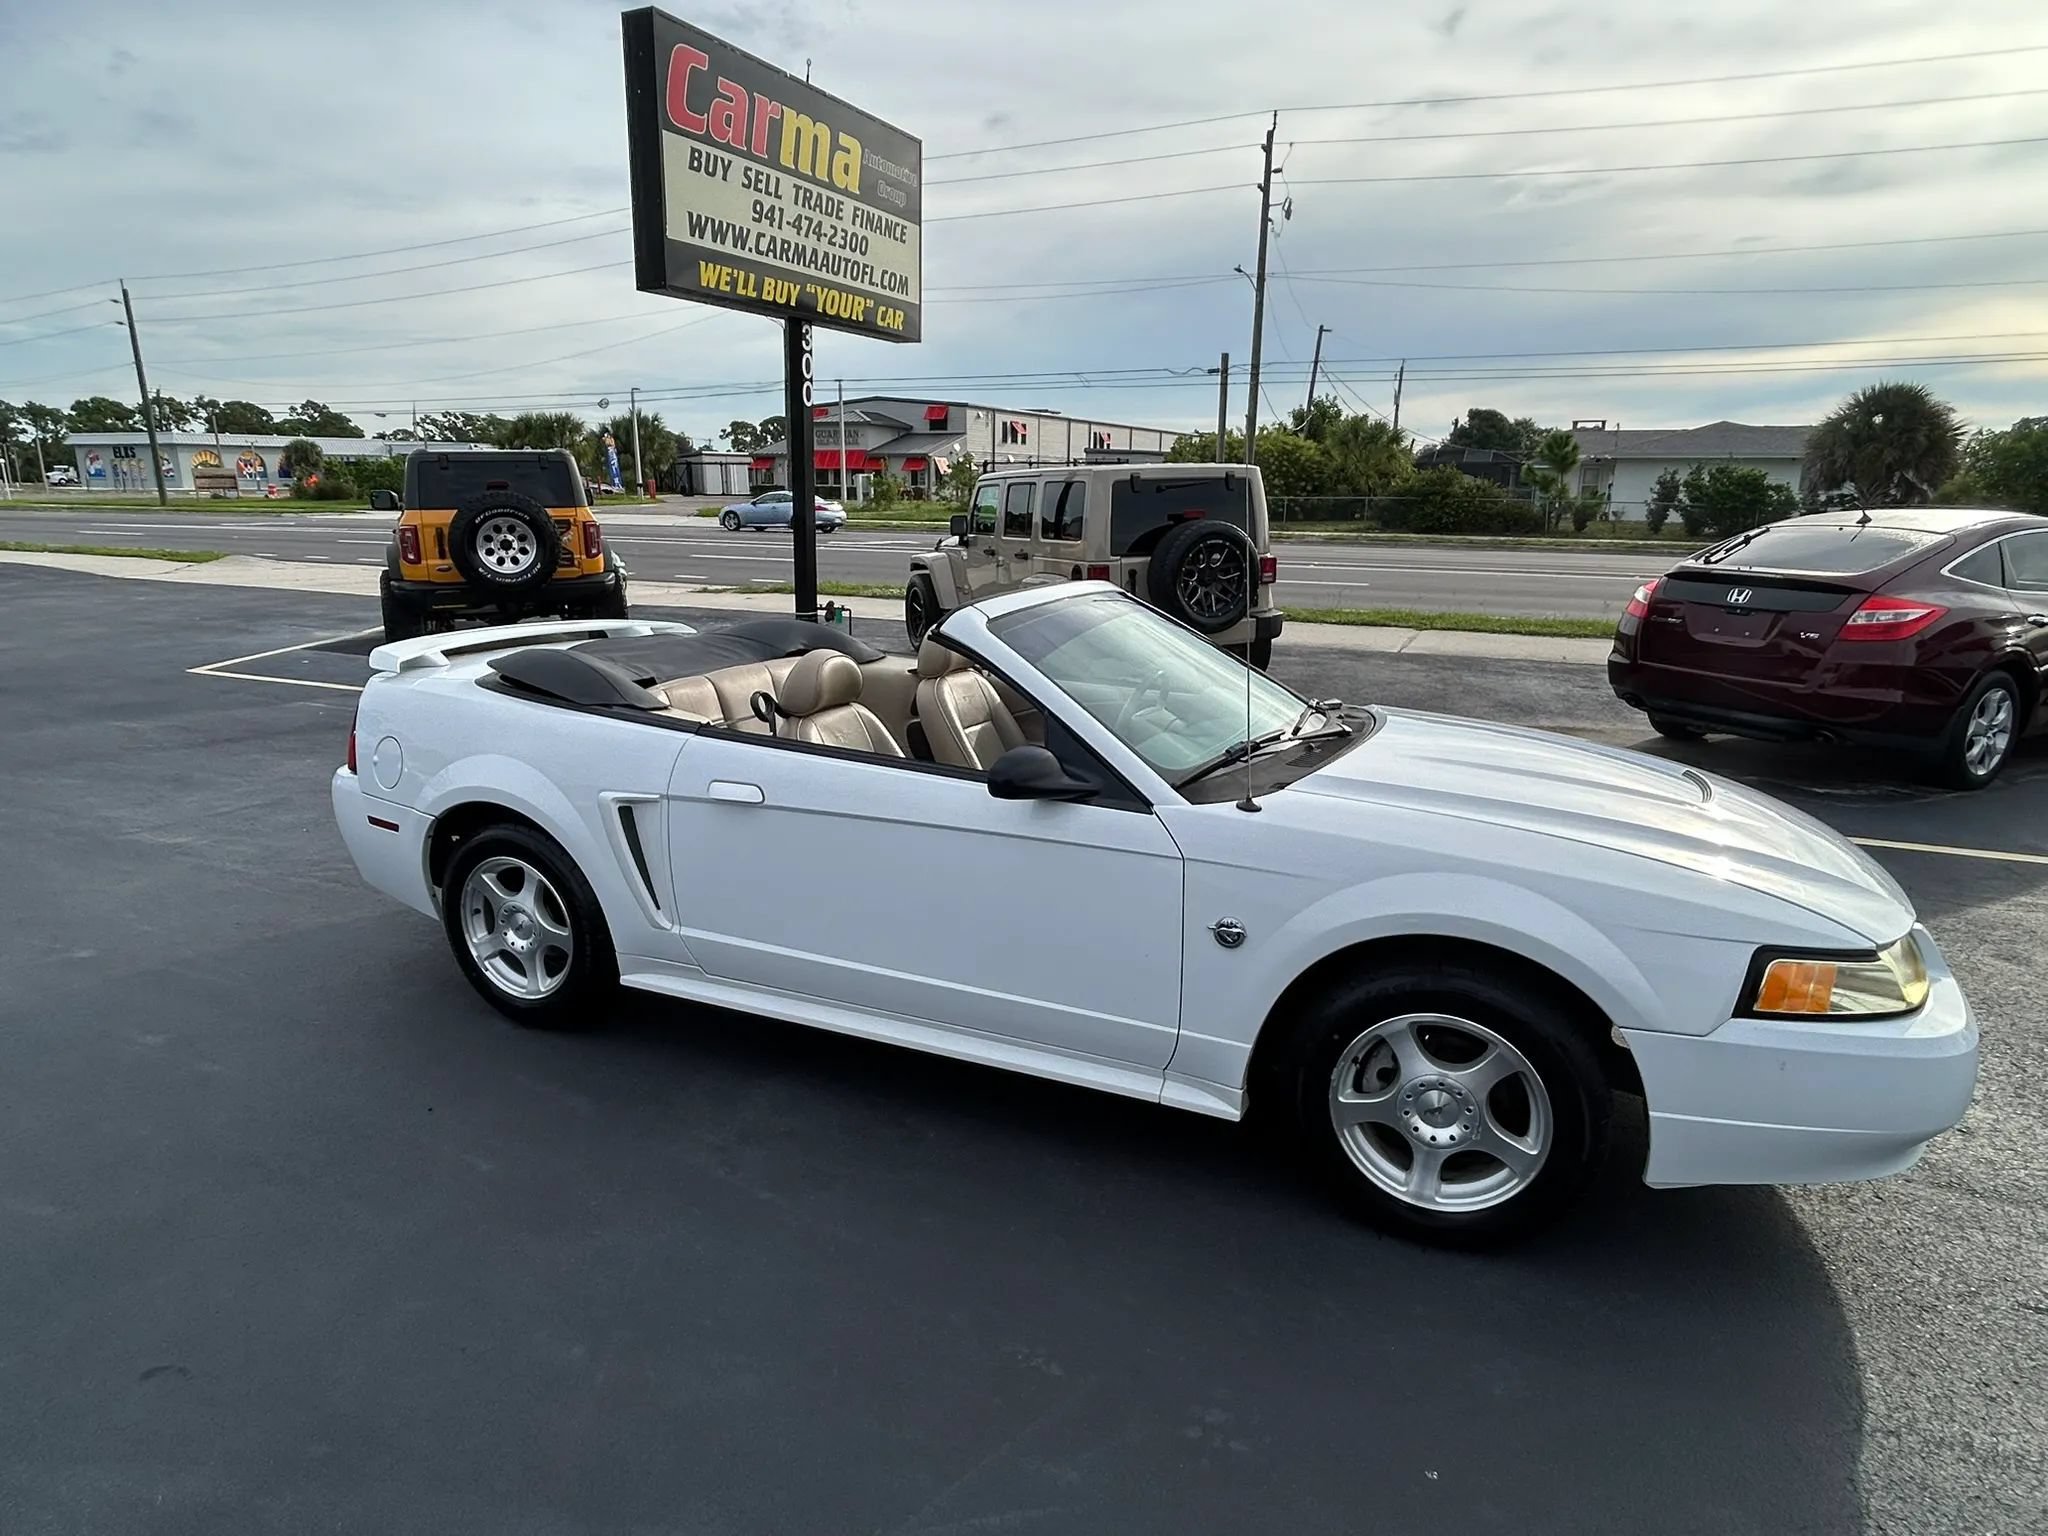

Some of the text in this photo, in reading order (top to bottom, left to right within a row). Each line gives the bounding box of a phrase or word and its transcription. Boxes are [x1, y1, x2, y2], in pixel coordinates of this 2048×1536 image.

[667, 43, 860, 194] Carma
[688, 146, 907, 244] BUY SELL TRADE FINANCE
[752, 199, 869, 256] 941-474-2300
[687, 211, 909, 296] WWW.CARMAAUTOFL.COM
[699, 260, 756, 298] WE'LL
[762, 277, 800, 307] BUY
[877, 305, 904, 331] CAR
[802, 324, 813, 407] 300
